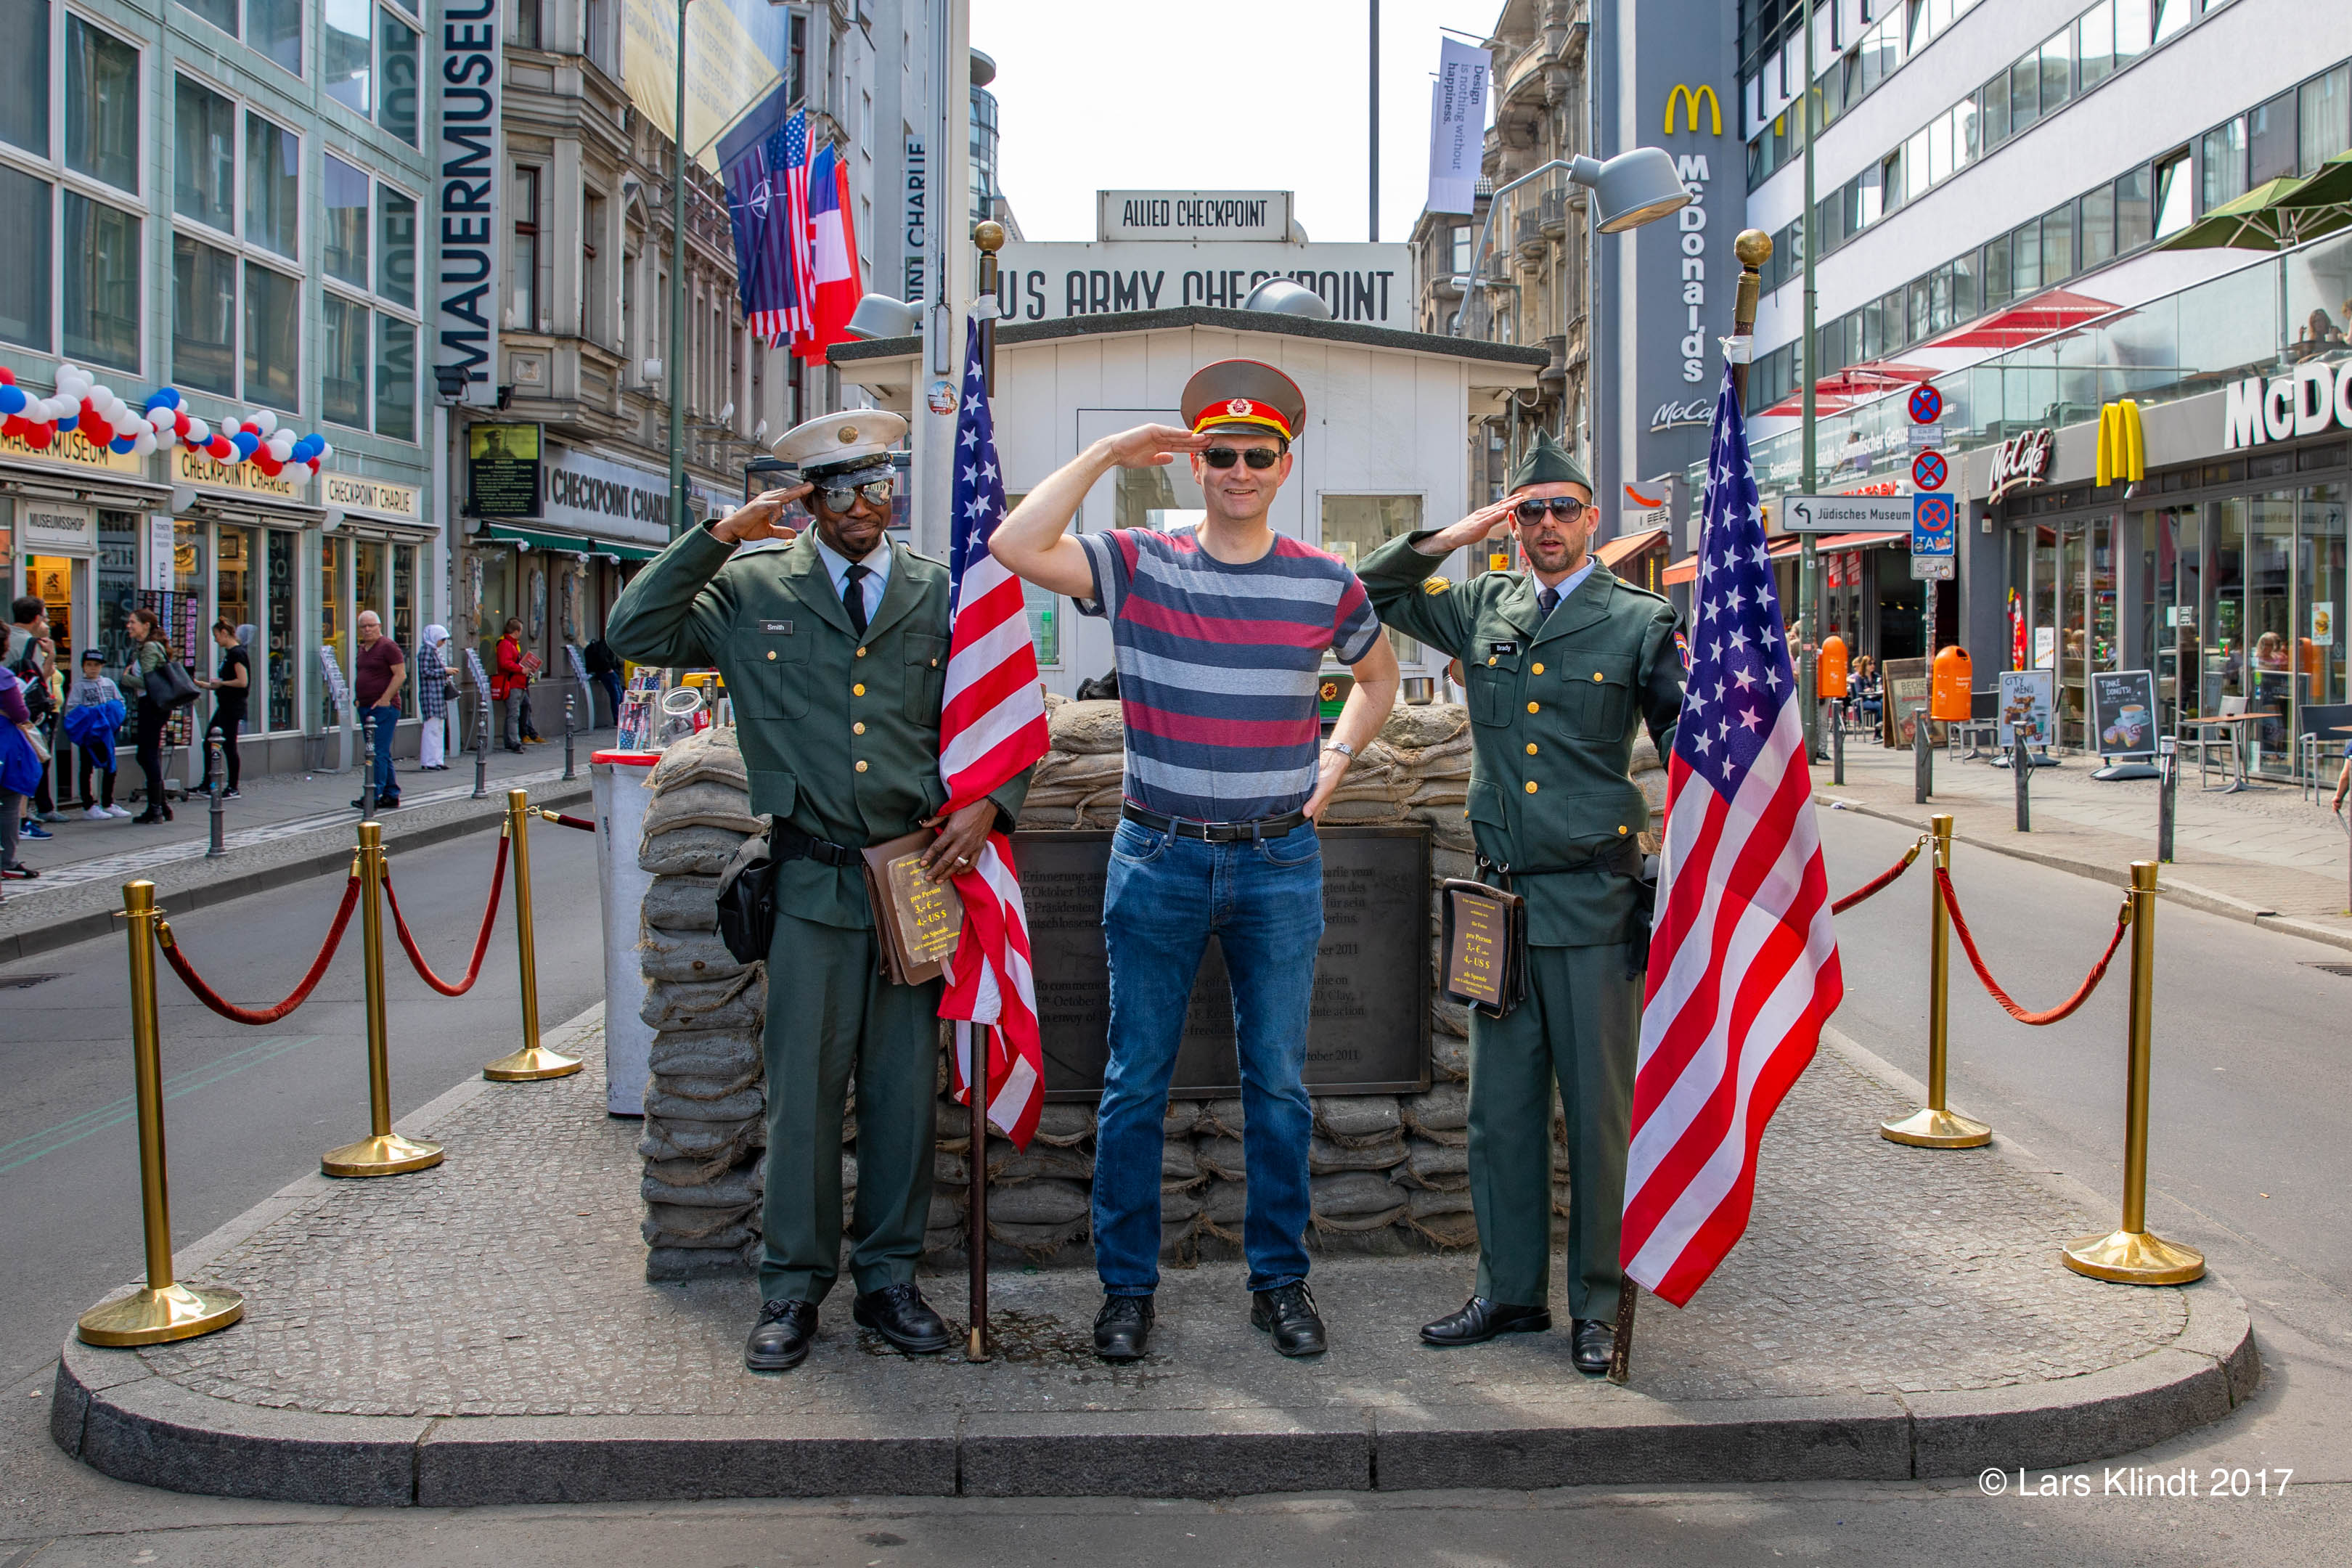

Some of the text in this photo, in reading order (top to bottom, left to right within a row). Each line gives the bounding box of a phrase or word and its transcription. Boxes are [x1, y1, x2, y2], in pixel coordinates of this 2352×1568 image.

[1470, 65, 1485, 105] Design
[1443, 62, 1459, 125] happiness.
[1453, 64, 1471, 170] is nothing without
[1123, 200, 1267, 228] ALLIED CHECKPOINT
[1067, 271, 1164, 314] ARMY
[330, 479, 410, 513] CHECKPOINT CHARLIE
[552, 468, 629, 518] CHECKPOINT
[1818, 507, 1911, 520] Jüdisches Museum
[29, 513, 86, 531] MUSEUMSSHOP
[2005, 677, 2024, 687] CITY
[2014, 685, 2034, 694] MENU
[910, 887, 942, 904] pro Person
[1032, 885, 1074, 897] Oktober
[1034, 900, 1095, 912] Präsidenten
[1344, 897, 1365, 908] sein
[928, 912, 940, 923] US
[1336, 943, 1359, 955] 2011
[1474, 957, 1484, 968] US
[1054, 995, 1097, 1007] October
[1334, 1003, 1365, 1017] action
[1336, 1049, 1359, 1061] 2011
